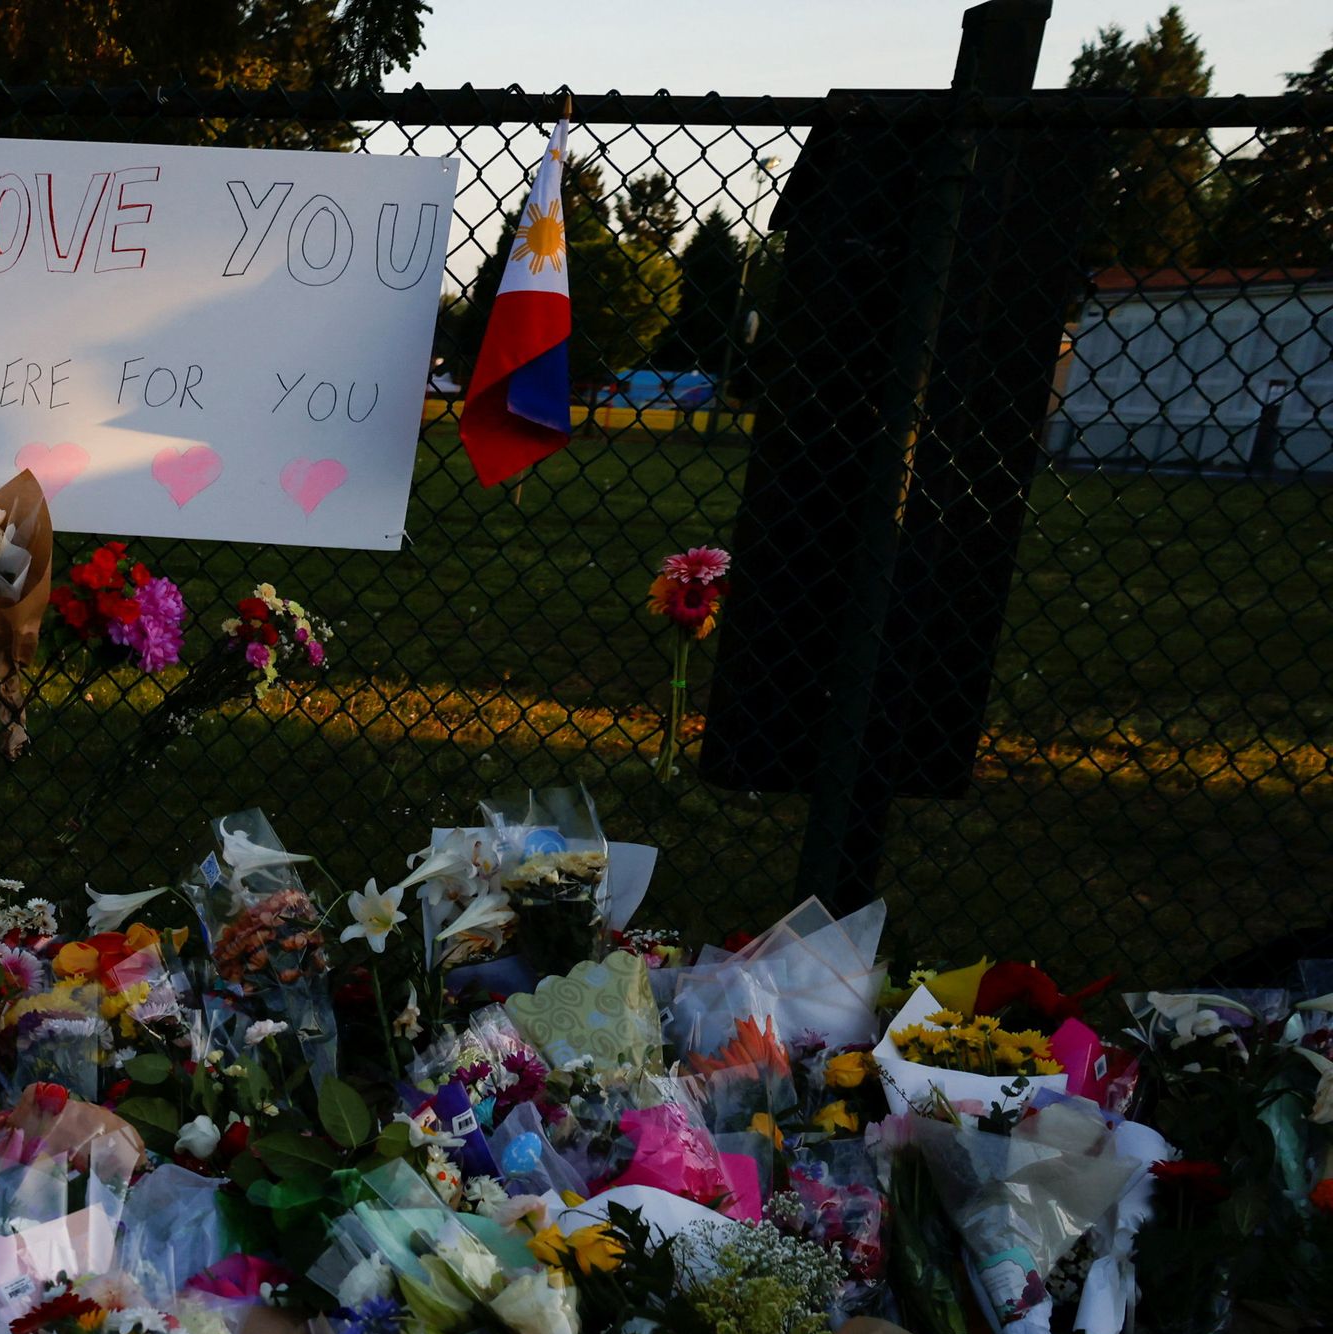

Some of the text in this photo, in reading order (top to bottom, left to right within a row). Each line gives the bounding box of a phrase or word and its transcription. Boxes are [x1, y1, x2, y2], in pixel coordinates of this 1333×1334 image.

[222, 180, 439, 291] YOU
[117, 356, 204, 411] FOR
[271, 372, 380, 424] YOU
